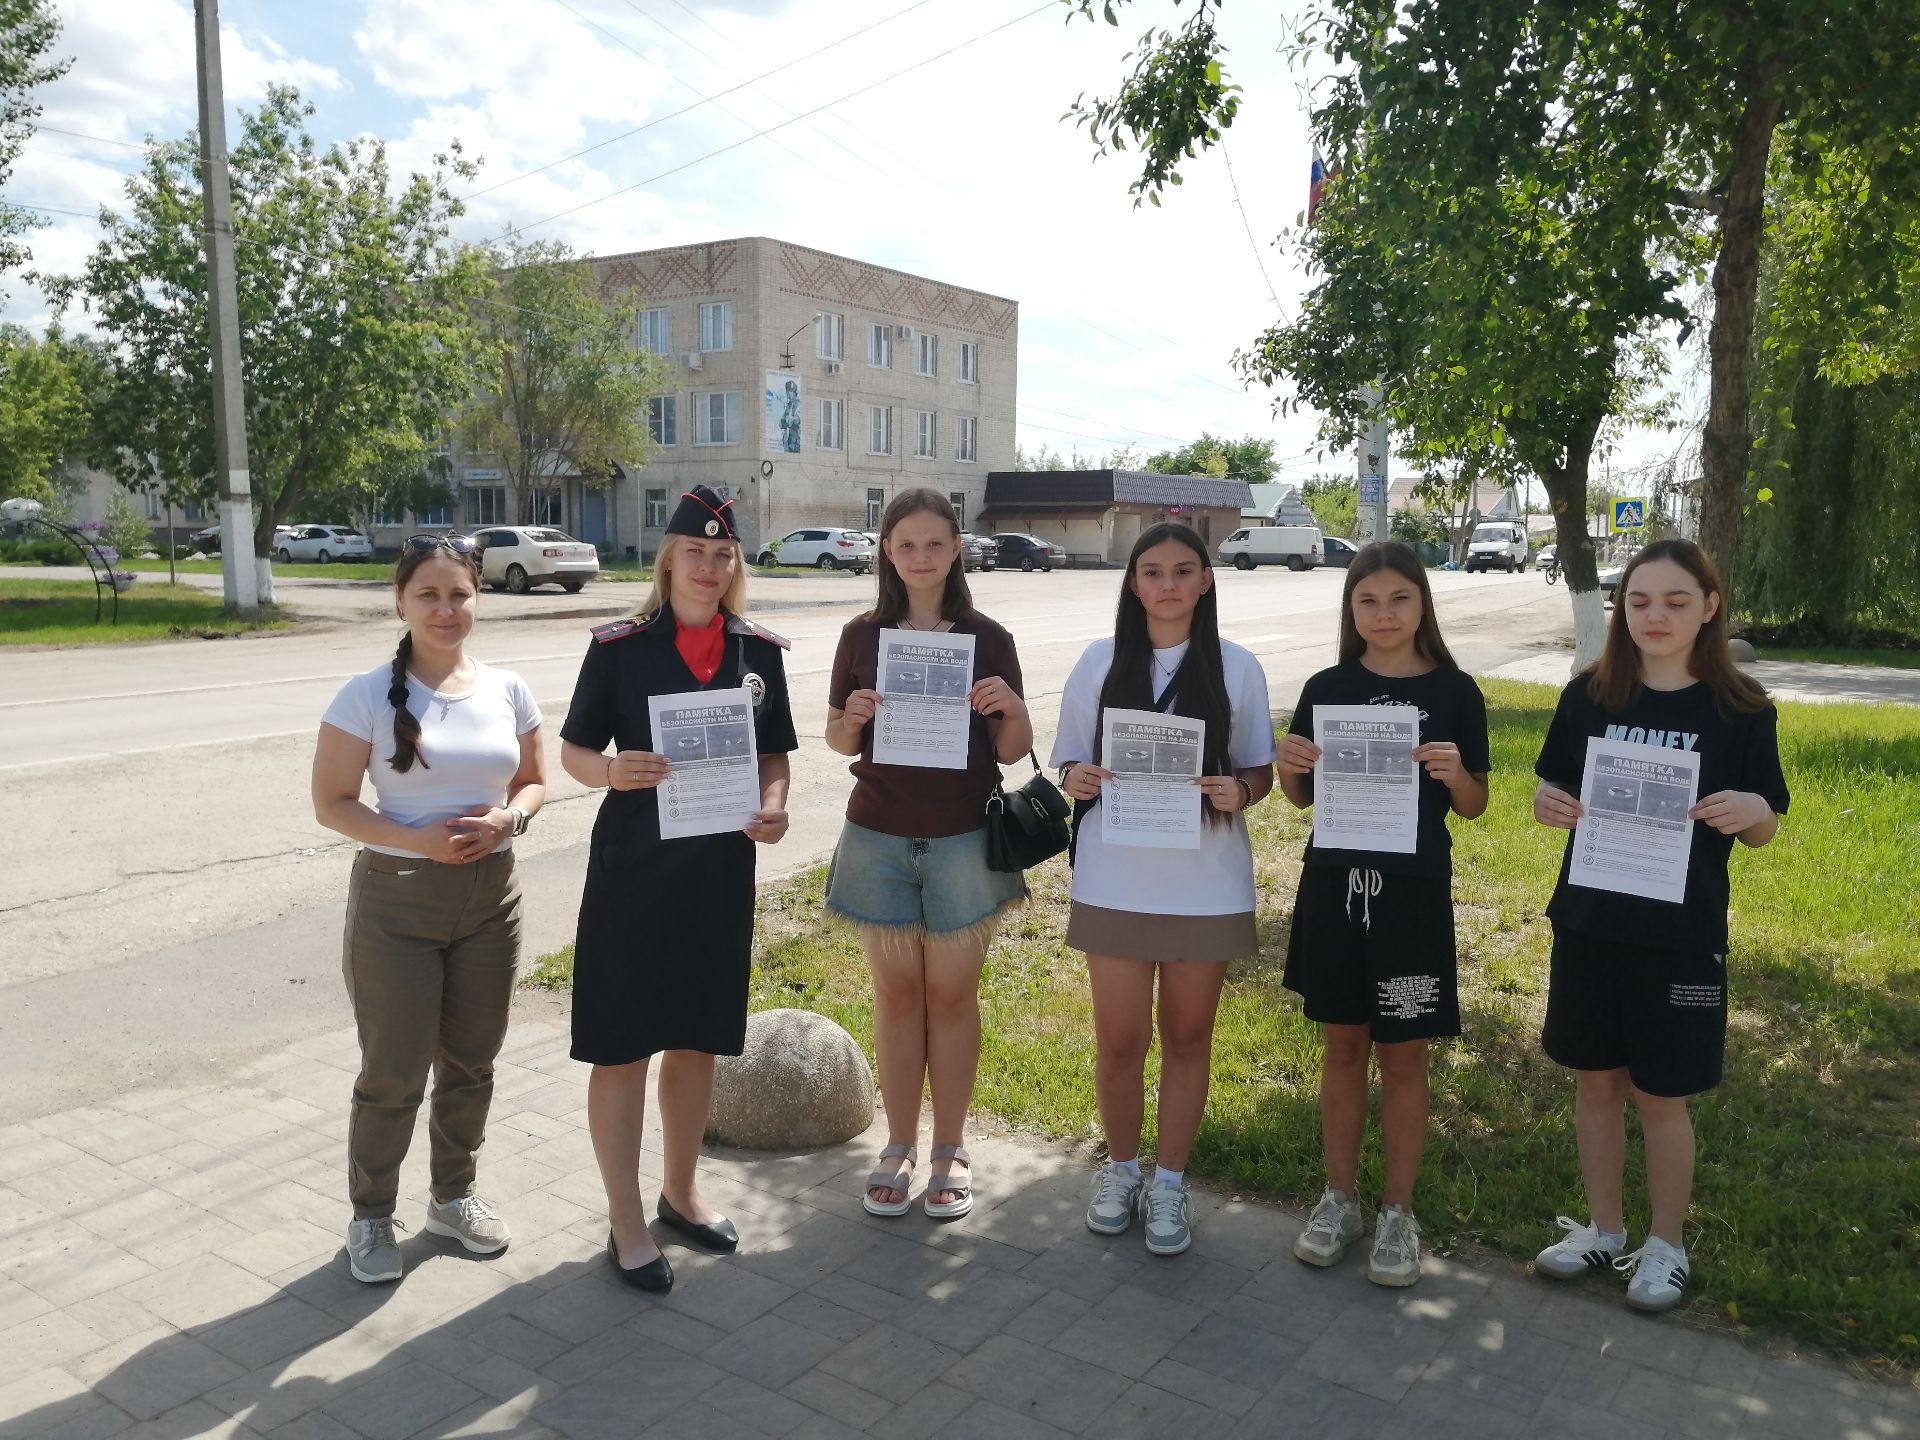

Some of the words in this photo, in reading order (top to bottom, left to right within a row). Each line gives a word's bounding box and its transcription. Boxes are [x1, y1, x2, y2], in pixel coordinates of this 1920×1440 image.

[888, 654, 939, 662] БЕЗОПАСНОСТИ
[903, 646, 954, 658] ПАМЯТКА
[676, 706, 732, 719] ПАМЯТКА
[662, 717, 716, 726] БЕЗОПАСНОСТИ
[1340, 722, 1396, 732] ПАМЯТКА
[1114, 732, 1166, 740] БЕЗОПАСНОСТИ
[1128, 724, 1183, 736] ПАМЯТКА
[1324, 730, 1379, 738] БЕЗОПАСНОСТИ
[1604, 724, 1699, 751] MONEY
[1614, 758, 1674, 775] ПАМЯТКА
[1597, 765, 1656, 780] БЕЗОПАСНОСТИ
[1657, 773, 1668, 782] НА
[1669, 776, 1691, 785] ВОДЕ
